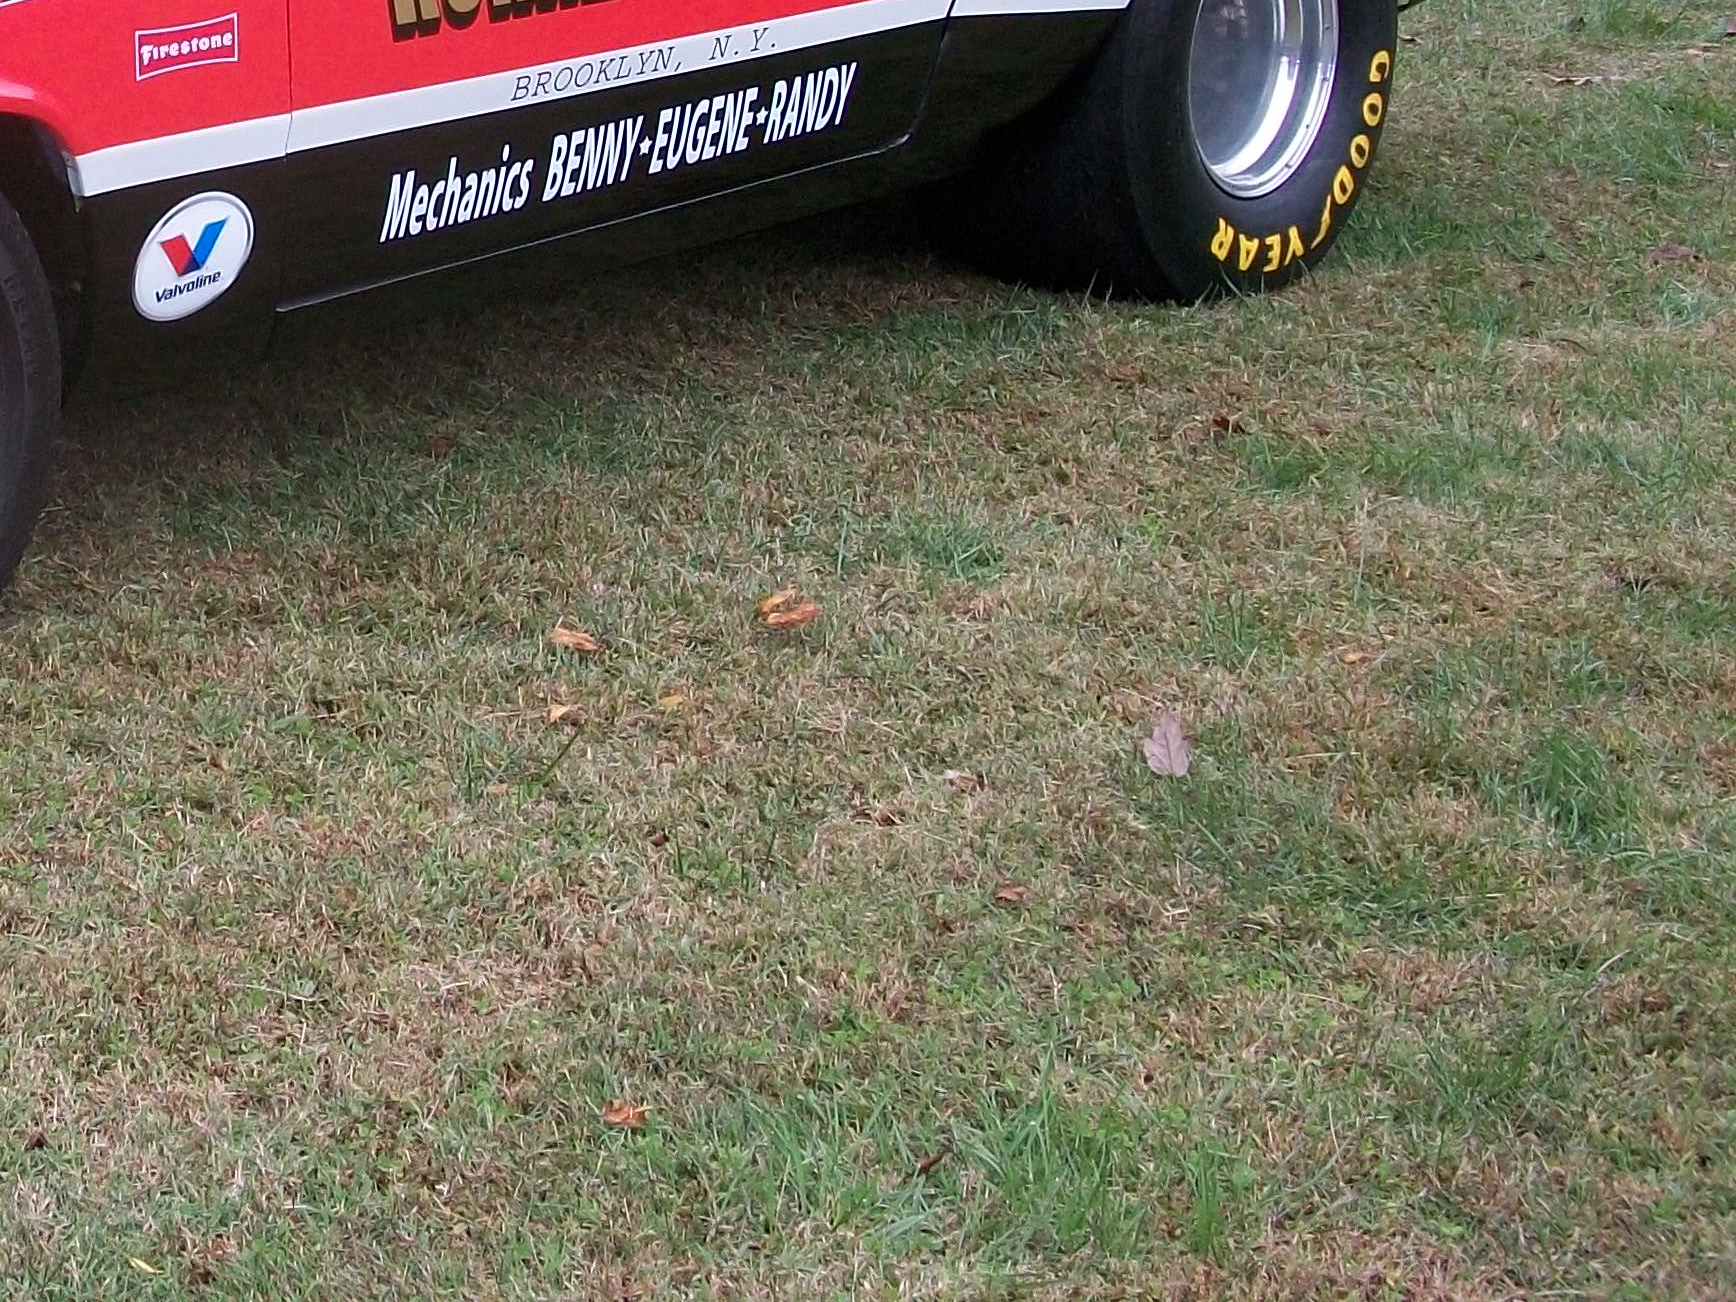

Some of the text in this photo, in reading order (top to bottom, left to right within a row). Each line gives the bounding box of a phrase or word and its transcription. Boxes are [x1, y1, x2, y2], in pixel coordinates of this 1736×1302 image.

[140, 32, 233, 65] Firestone
[510, 46, 683, 101] BROOKLYN,
[380, 62, 857, 242] Mechanics BENNY EUGENE RANDY
[155, 271, 221, 303] Valvoline
